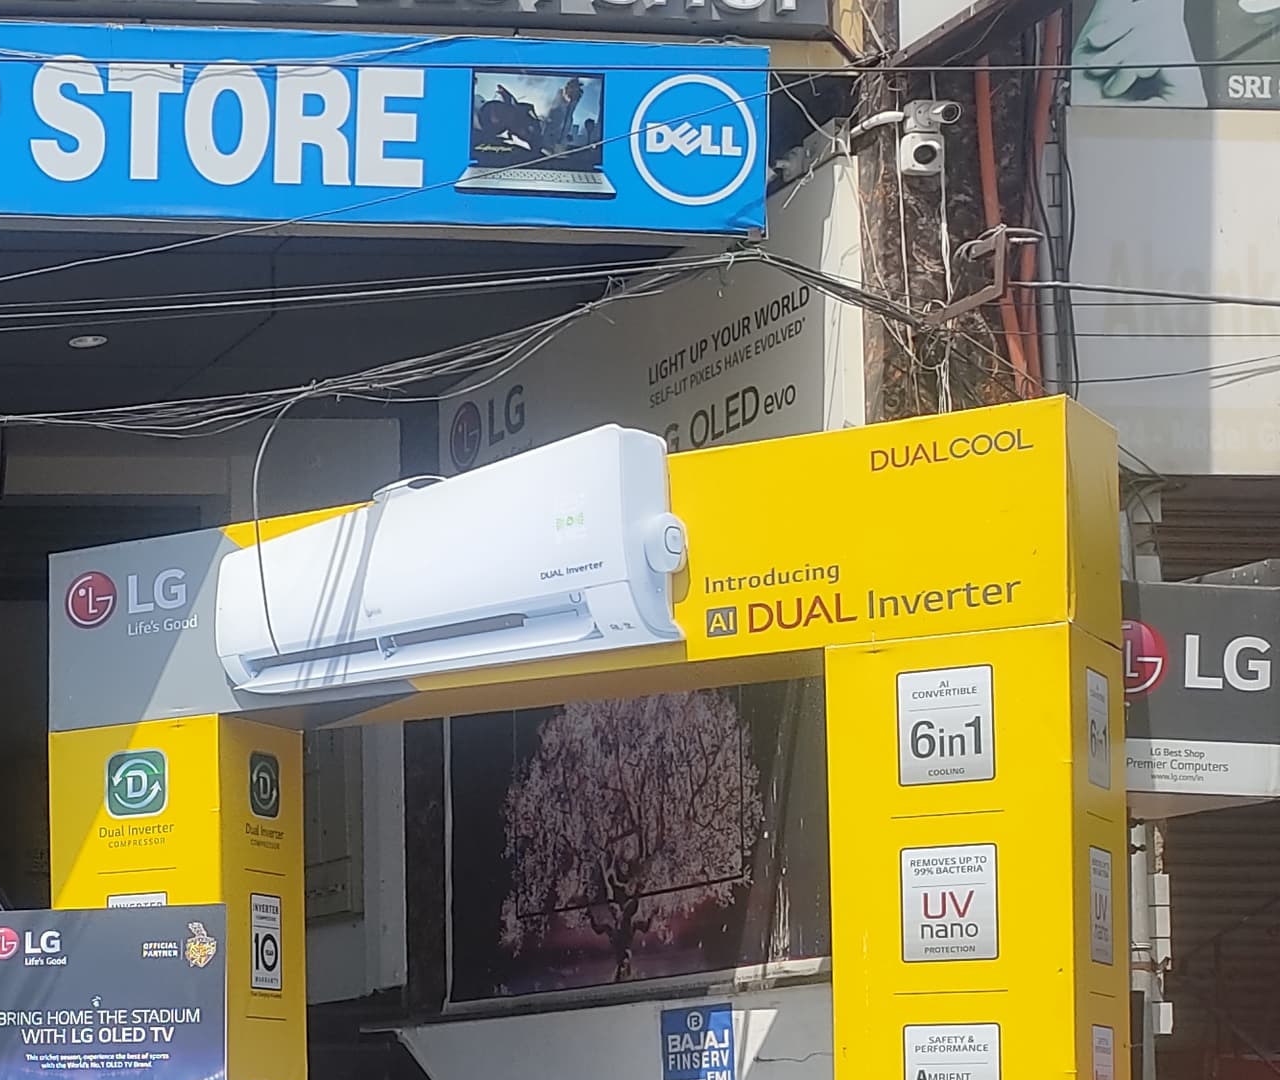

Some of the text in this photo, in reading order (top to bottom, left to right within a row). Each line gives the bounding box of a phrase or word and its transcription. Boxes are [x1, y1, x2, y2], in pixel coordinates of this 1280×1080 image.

[1227, 74, 1272, 98] SRI
[29, 54, 425, 188] STORE
[643, 120, 743, 160] DELL
[647, 284, 812, 386] LIGHT UP YOUR WORLD
[648, 379, 689, 410] SELF-LIT
[723, 347, 753, 375] HAVE
[487, 384, 527, 448] LG
[689, 384, 797, 449] OLED evo
[870, 427, 1034, 473] DUALCOOL
[539, 560, 605, 581] DUAL Inverter
[704, 563, 842, 594] Introducing
[126, 567, 188, 615] LG
[708, 579, 1022, 636] AI DUAL Inverter
[127, 613, 199, 637] Life's Good
[1184, 632, 1272, 693] LG
[911, 685, 978, 700] CONVERTIBLE
[910, 715, 983, 760] 6in1
[1149, 746, 1206, 760] LG Best Shop
[927, 767, 965, 777] COOLING
[1126, 757, 1230, 774] Premier Computers
[98, 821, 176, 840] Dual Inverter
[107, 837, 167, 849] COMPRESSOR
[909, 855, 988, 868] REMOVES UP TO
[913, 864, 984, 877] 99% BACTERIA
[922, 889, 975, 920] UV
[919, 921, 979, 940] nano
[24, 931, 61, 954] LG
[142, 942, 178, 950] OFFICIAL
[142, 949, 178, 958] PARTNER
[923, 944, 976, 955] PROTECTION
[24, 956, 67, 967] Life's Good
[46, 1009, 93, 1026] HOME
[96, 1008, 129, 1025] THE
[130, 1007, 201, 1024] STADIUM
[20, 1025, 175, 1045] WITH LG OLED TV
[667, 1028, 730, 1054] BAJAJ
[927, 1035, 965, 1046] SAFETY
[914, 1043, 990, 1054] PERFORMANCE
[668, 1049, 730, 1072] FINSERV
